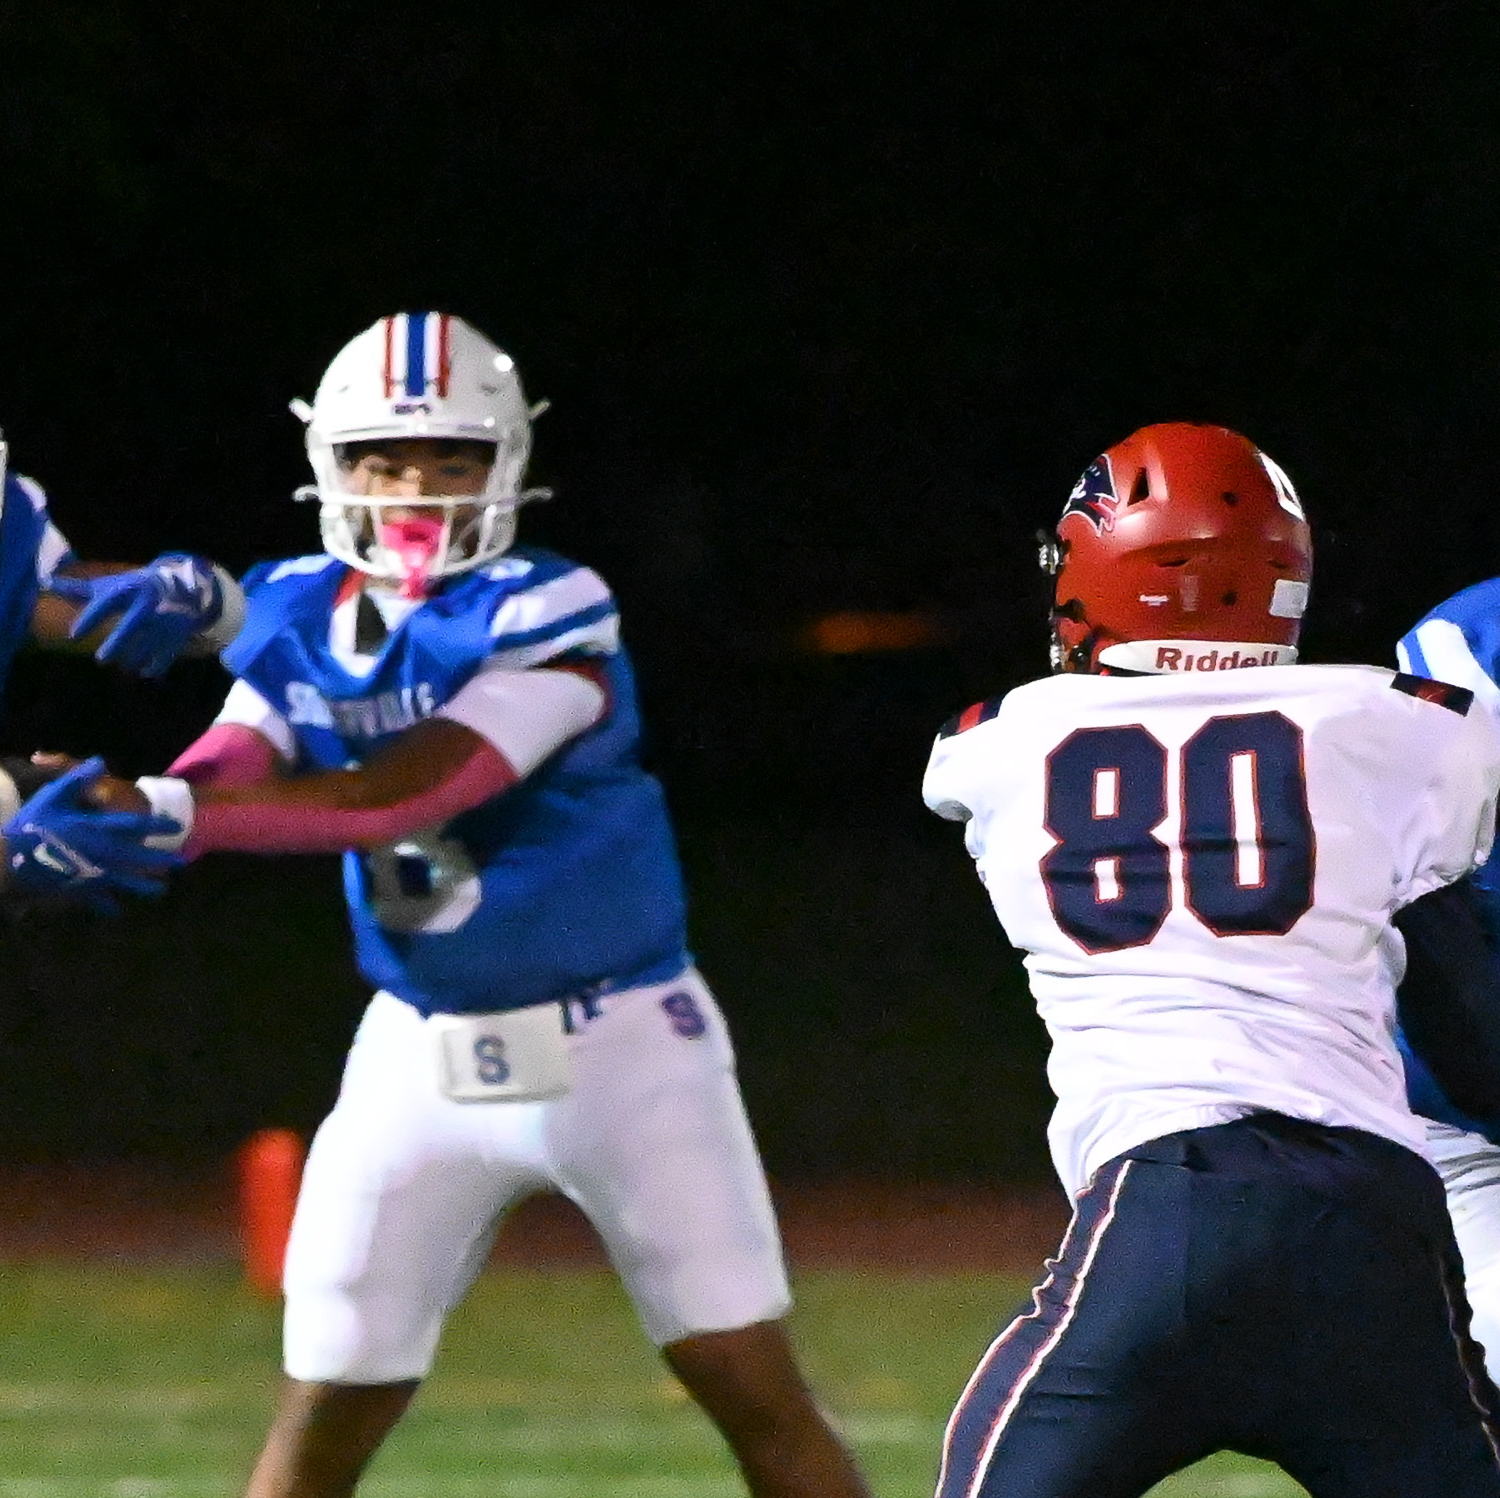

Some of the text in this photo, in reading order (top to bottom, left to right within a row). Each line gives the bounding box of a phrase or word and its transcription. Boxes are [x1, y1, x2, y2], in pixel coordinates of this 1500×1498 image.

[1155, 647, 1279, 672] Riddell
[1039, 710, 1317, 956] 80
[474, 1033, 511, 1086] S
